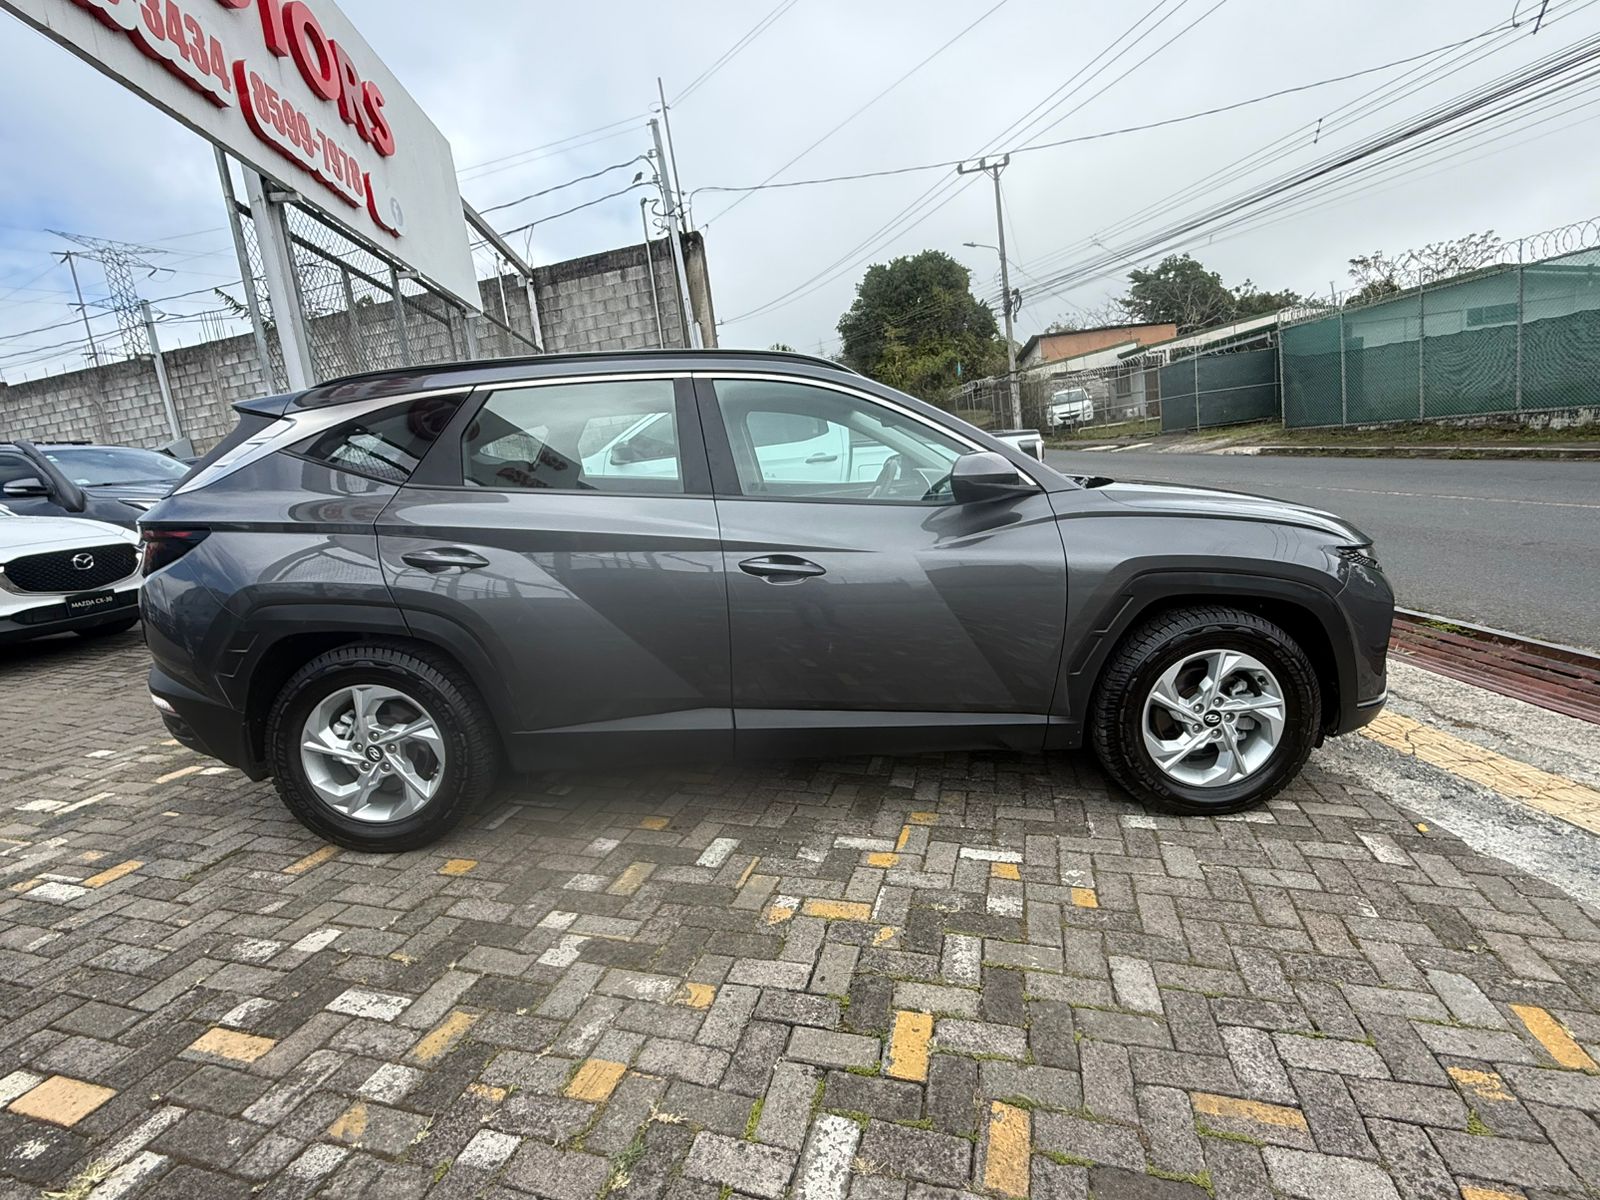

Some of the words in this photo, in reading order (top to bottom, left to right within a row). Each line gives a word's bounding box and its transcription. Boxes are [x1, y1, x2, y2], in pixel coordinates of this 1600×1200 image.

[106, 0, 231, 94] 3434
[249, 71, 364, 198] 8599-7978
[71, 599, 95, 608] MAZDA
